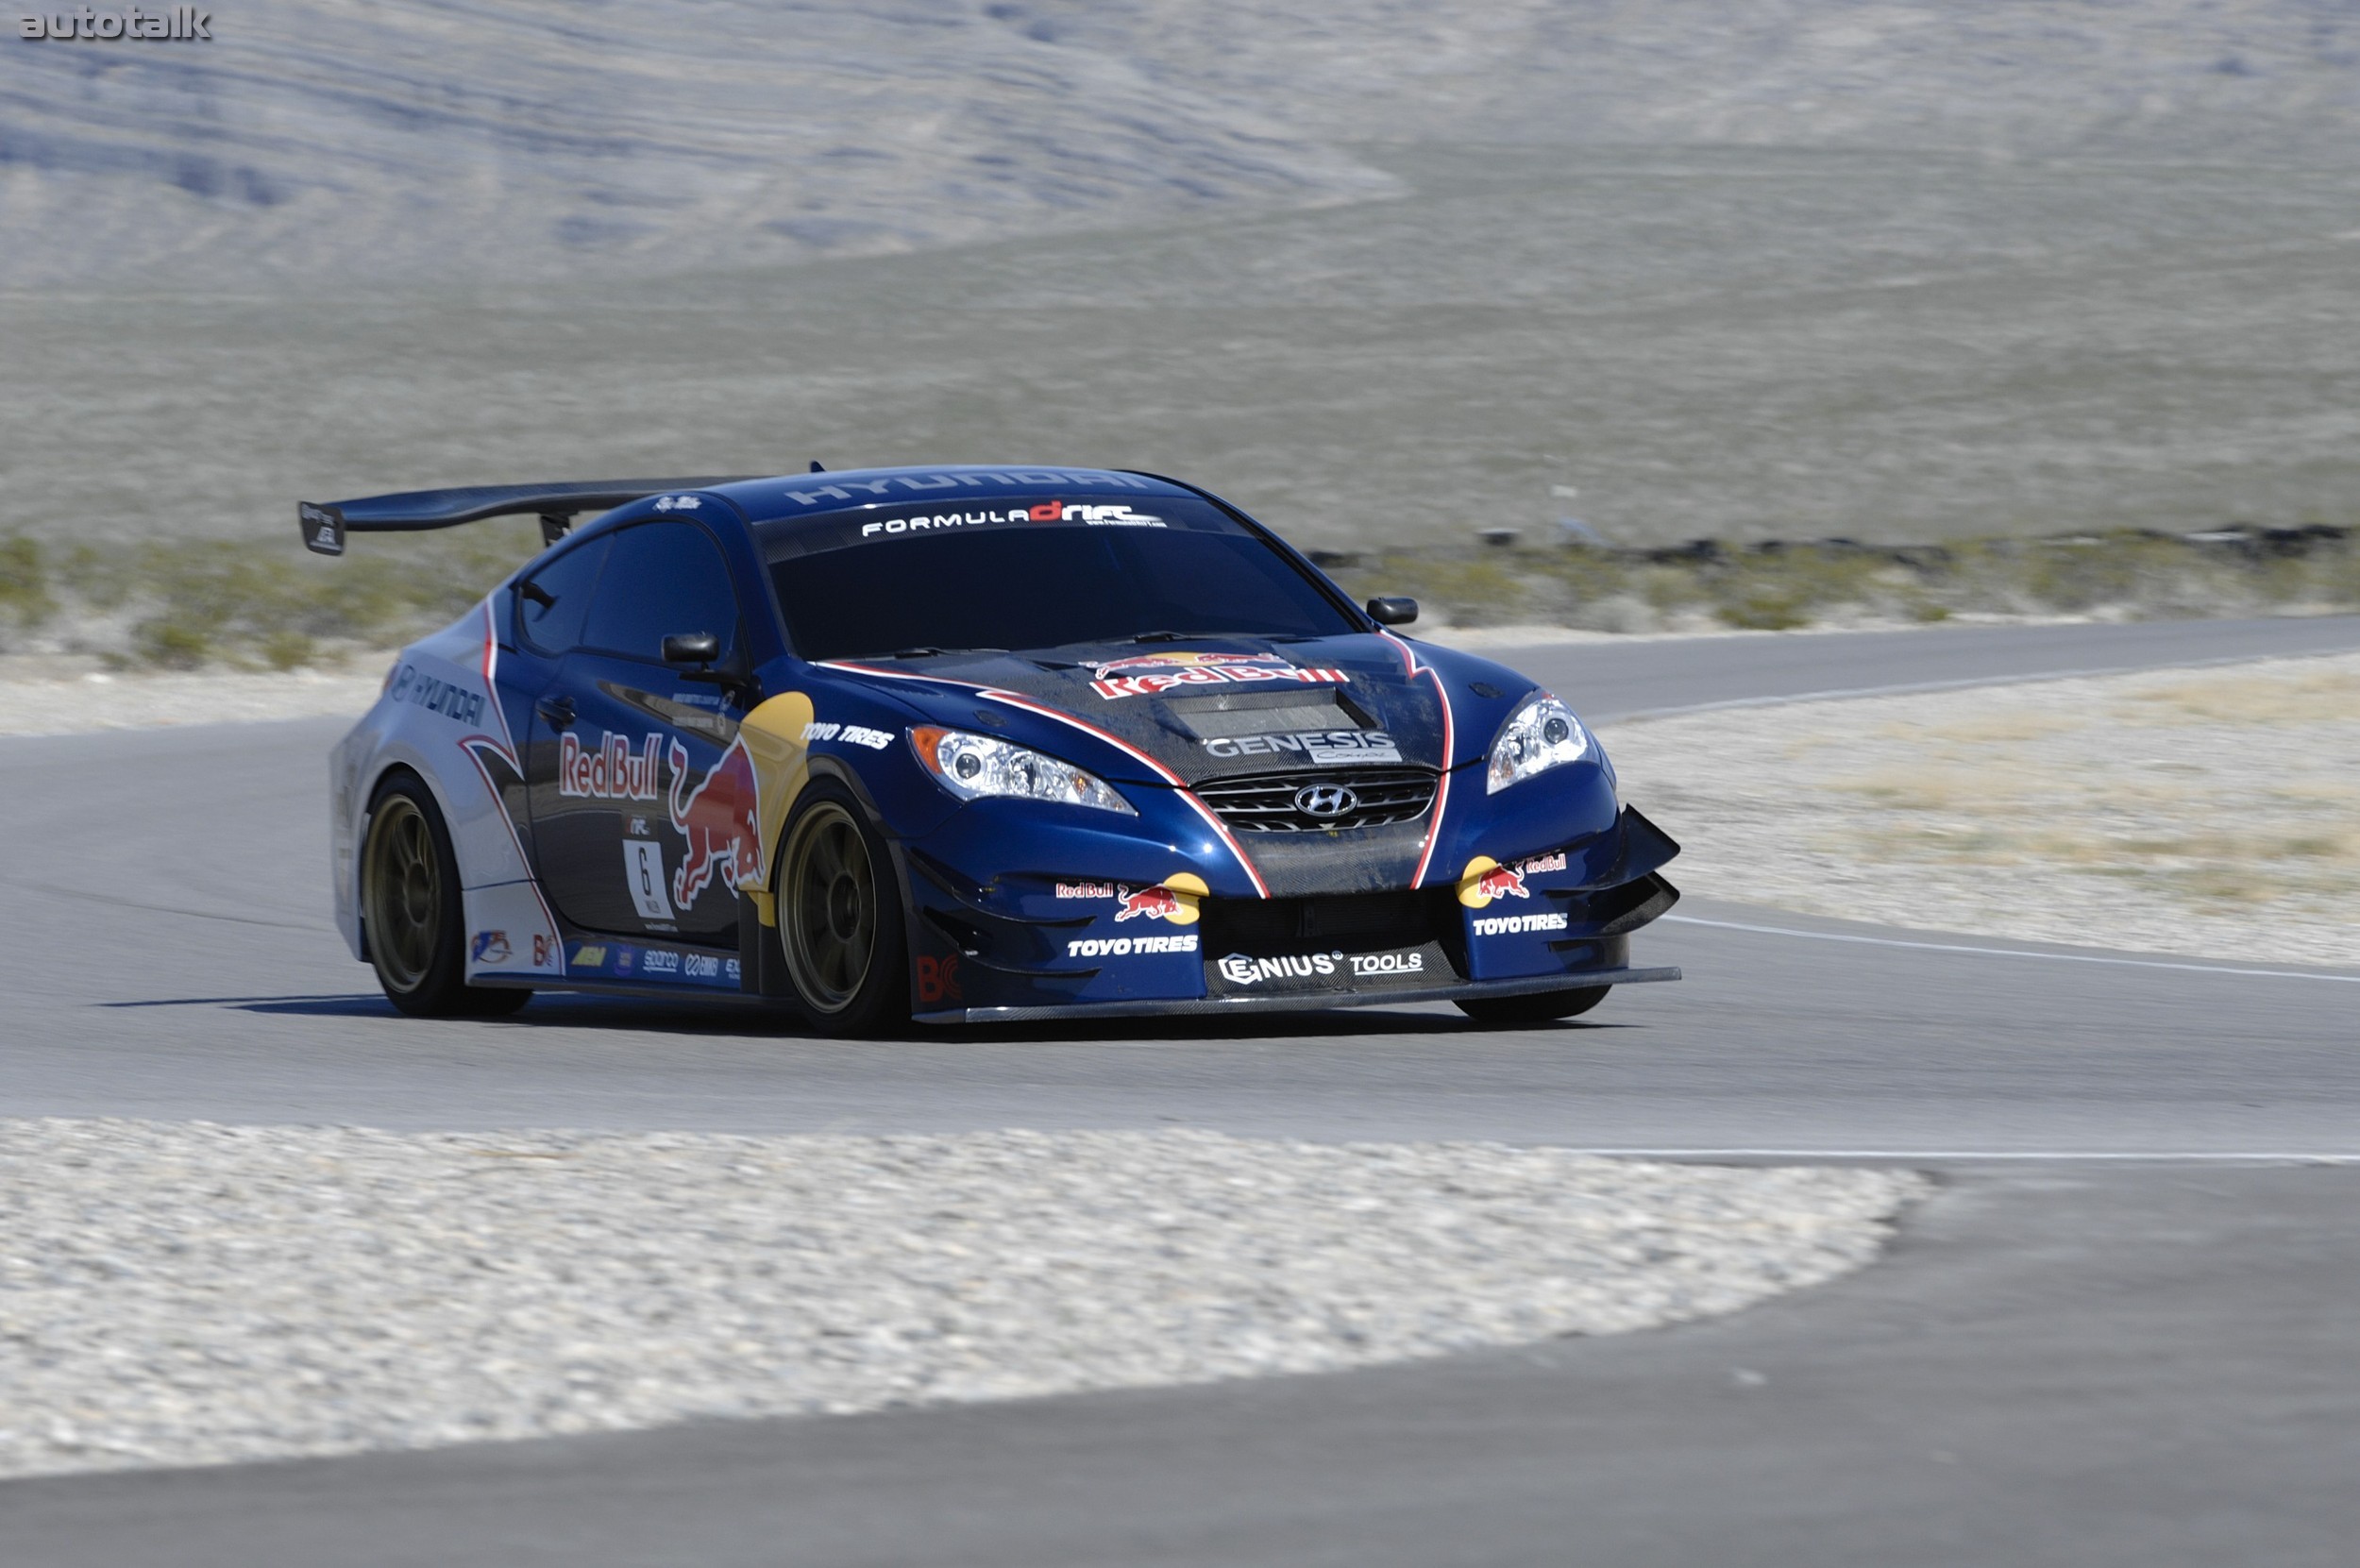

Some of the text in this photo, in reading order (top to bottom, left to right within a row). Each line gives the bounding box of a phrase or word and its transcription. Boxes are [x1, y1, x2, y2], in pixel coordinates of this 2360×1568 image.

[784, 473, 1149, 506] HYUNDAI
[409, 673, 486, 729] HYUNDAI
[837, 725, 896, 750] TIRES
[1206, 732, 1396, 758] GENESIS
[638, 847, 652, 896] 6
[1068, 934, 1199, 957] TOYO TIRES
[1350, 953, 1423, 973] TOOLS
